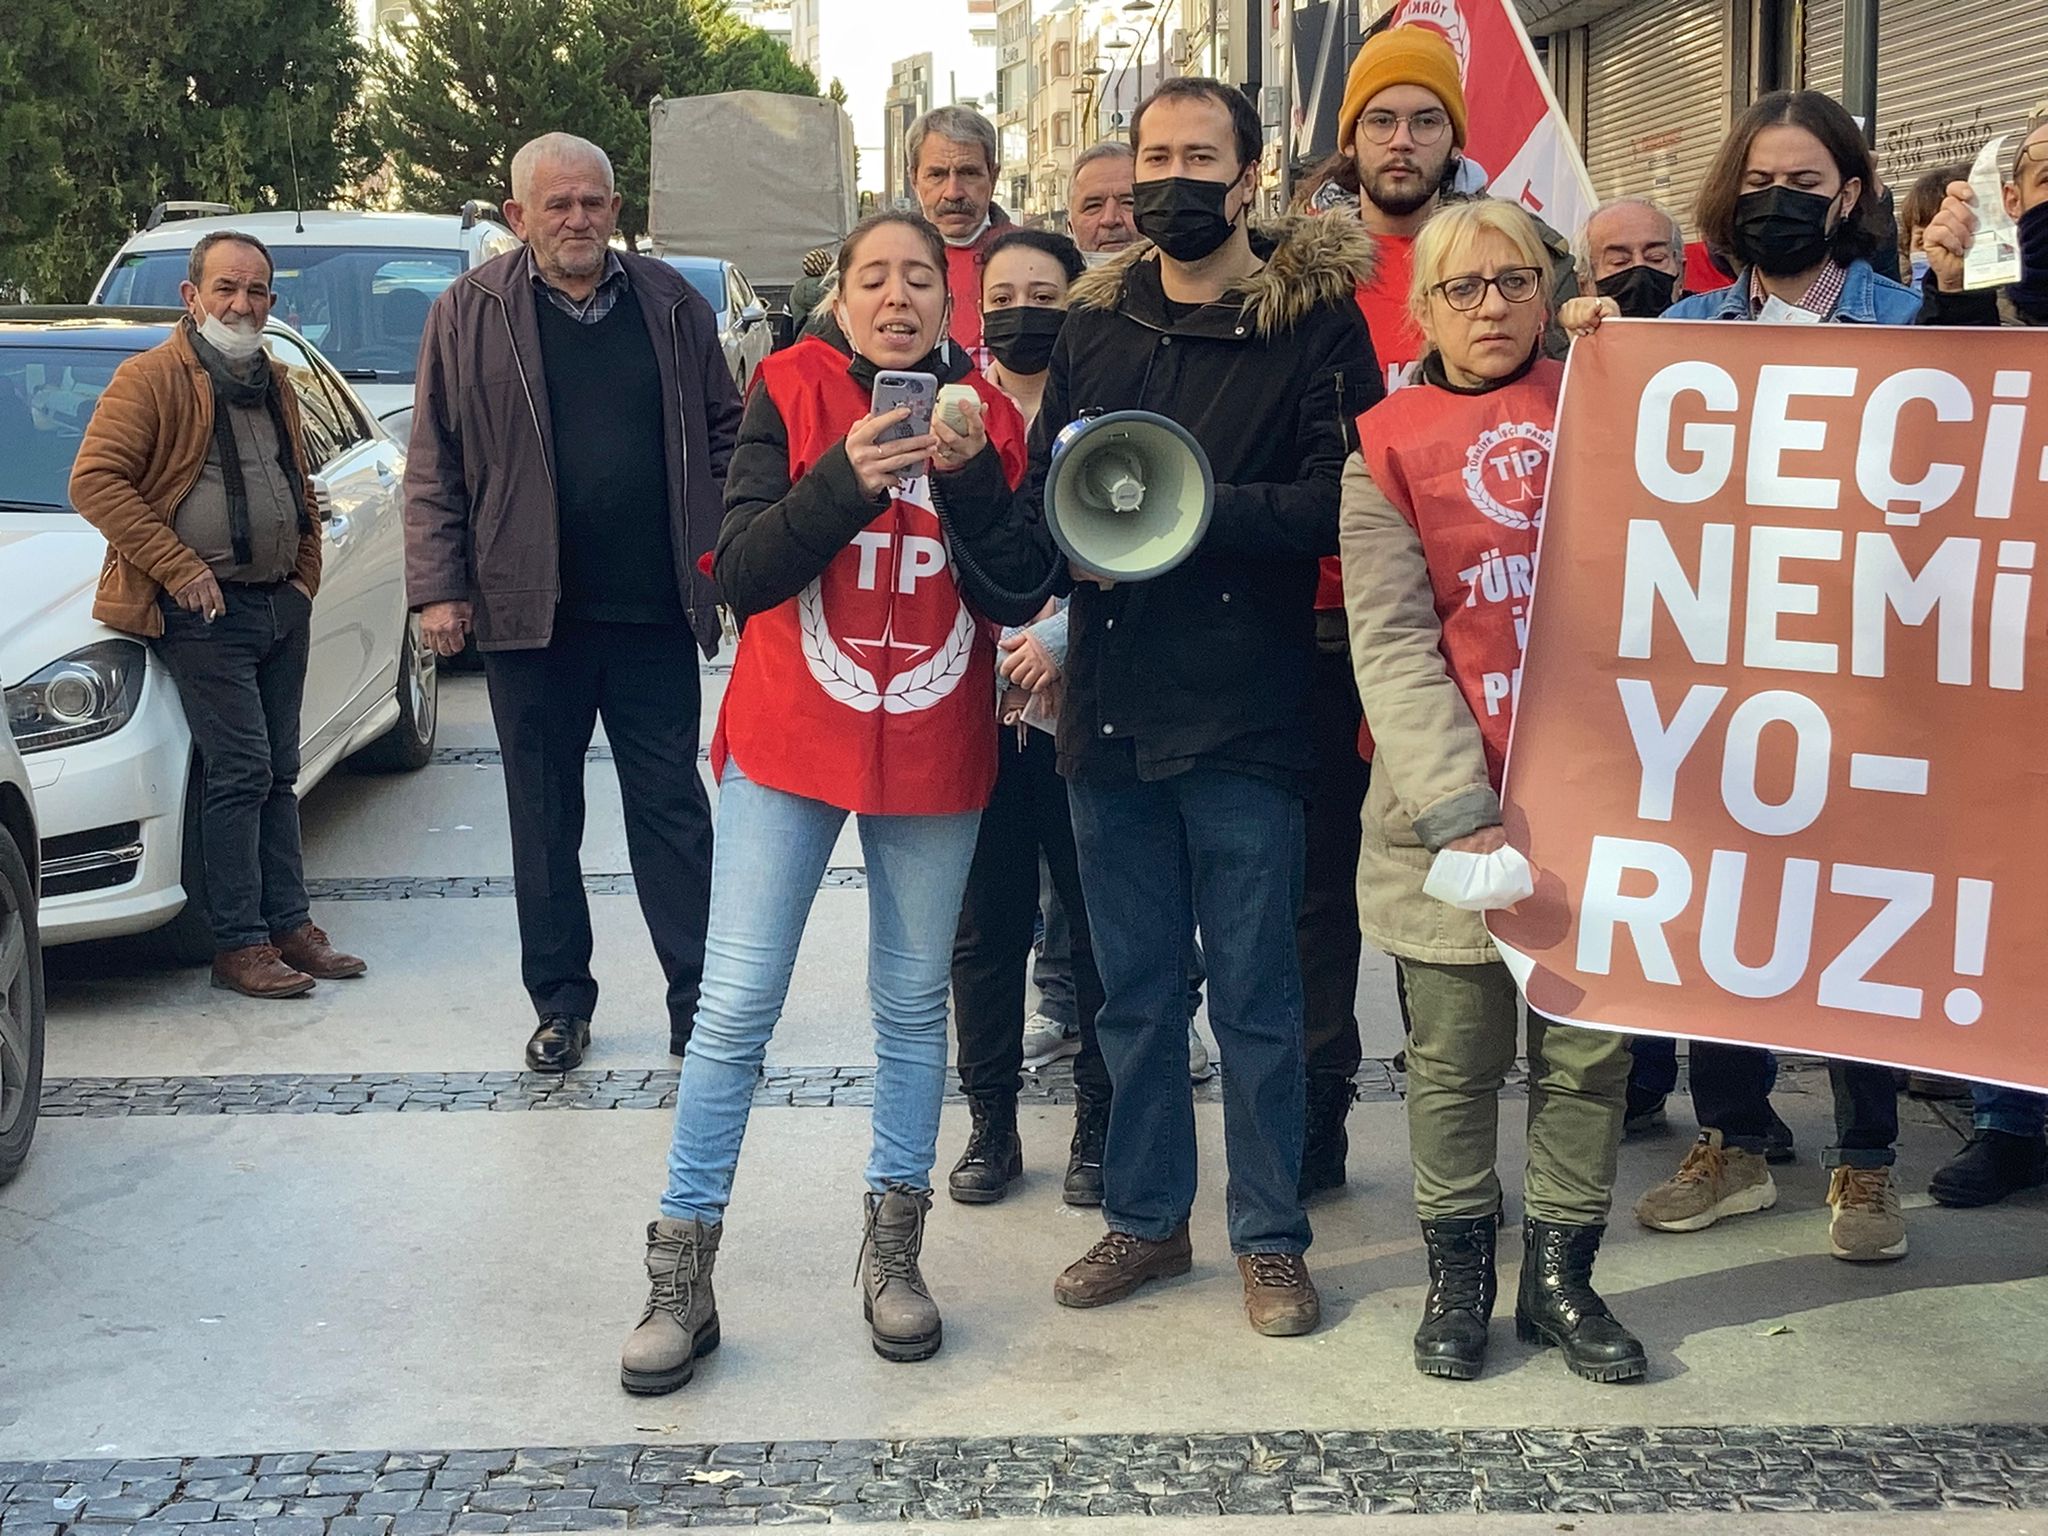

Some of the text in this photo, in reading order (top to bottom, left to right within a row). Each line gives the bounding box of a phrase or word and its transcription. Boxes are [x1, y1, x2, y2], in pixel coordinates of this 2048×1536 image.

[1489, 446, 1543, 481] TİP
[1634, 360, 2048, 526] GEÇİ
[849, 530, 947, 595] TP
[1615, 678, 1929, 836] YO-
[1575, 834, 1993, 1026] RUZ!
